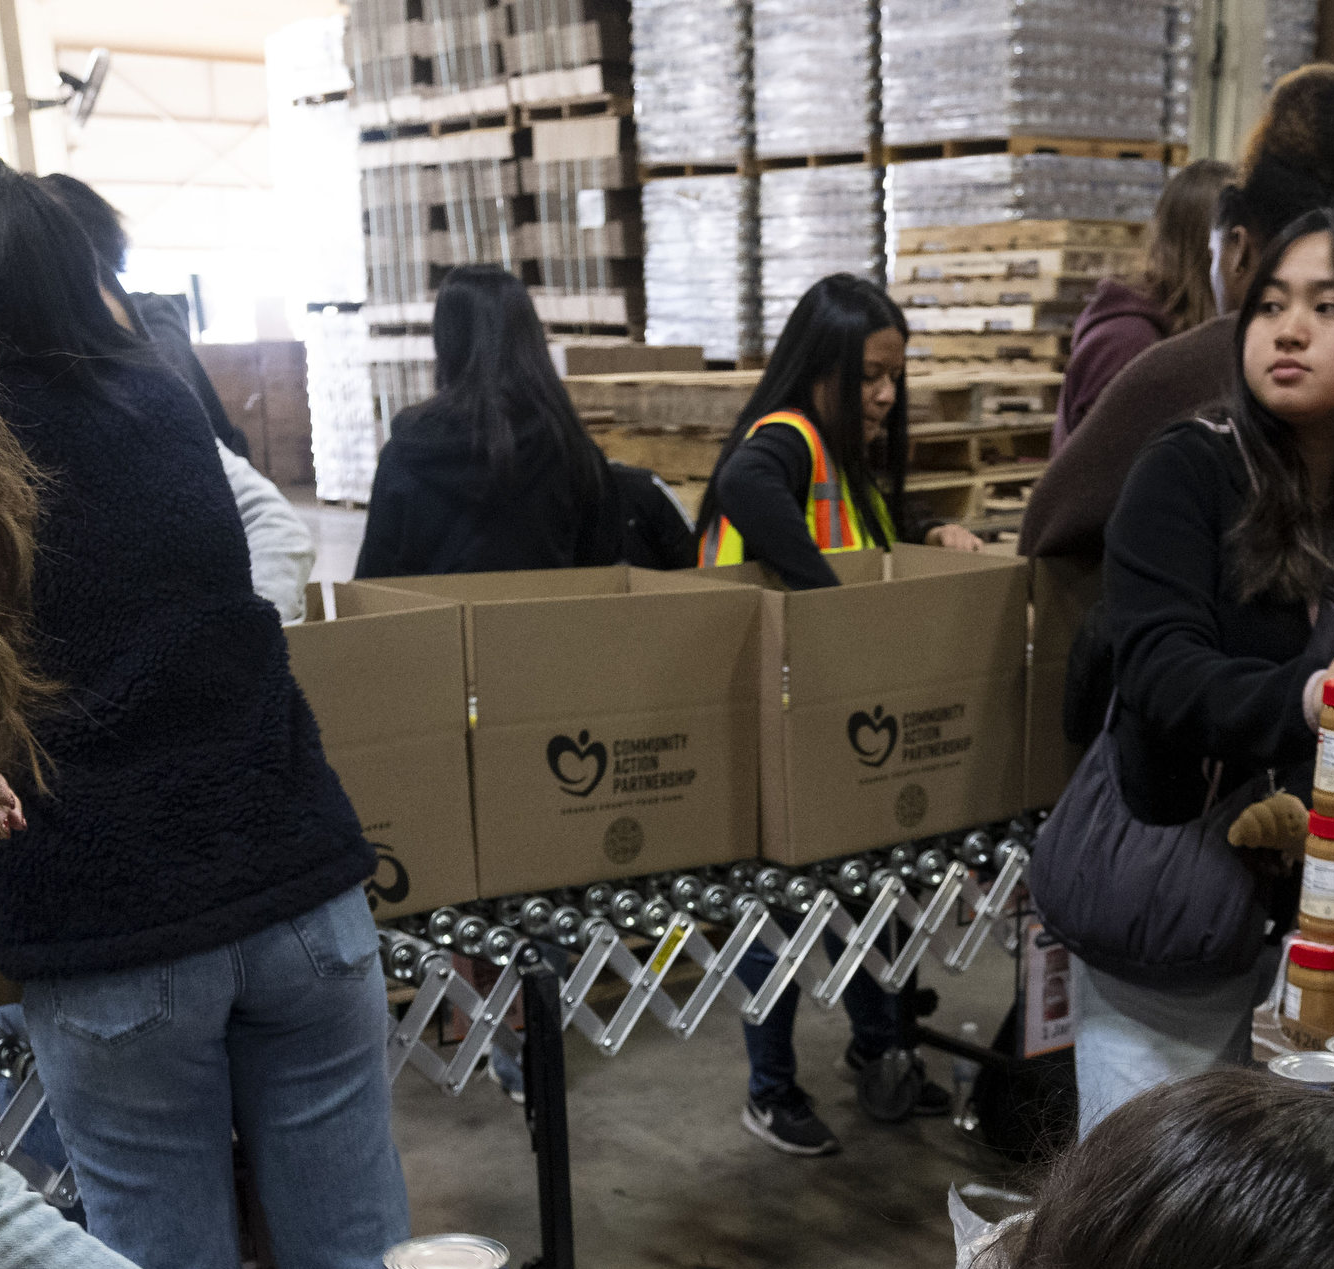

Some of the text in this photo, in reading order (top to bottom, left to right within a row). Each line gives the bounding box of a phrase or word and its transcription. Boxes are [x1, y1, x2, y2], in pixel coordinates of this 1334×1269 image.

[903, 703, 965, 728] COMMUNITY
[614, 733, 689, 758] COMMUNITY
[903, 726, 941, 745] ACTION
[903, 737, 972, 761] PARTNERSHIP
[614, 755, 660, 775] ACTION
[614, 768, 698, 794] PARTNERSHIP
